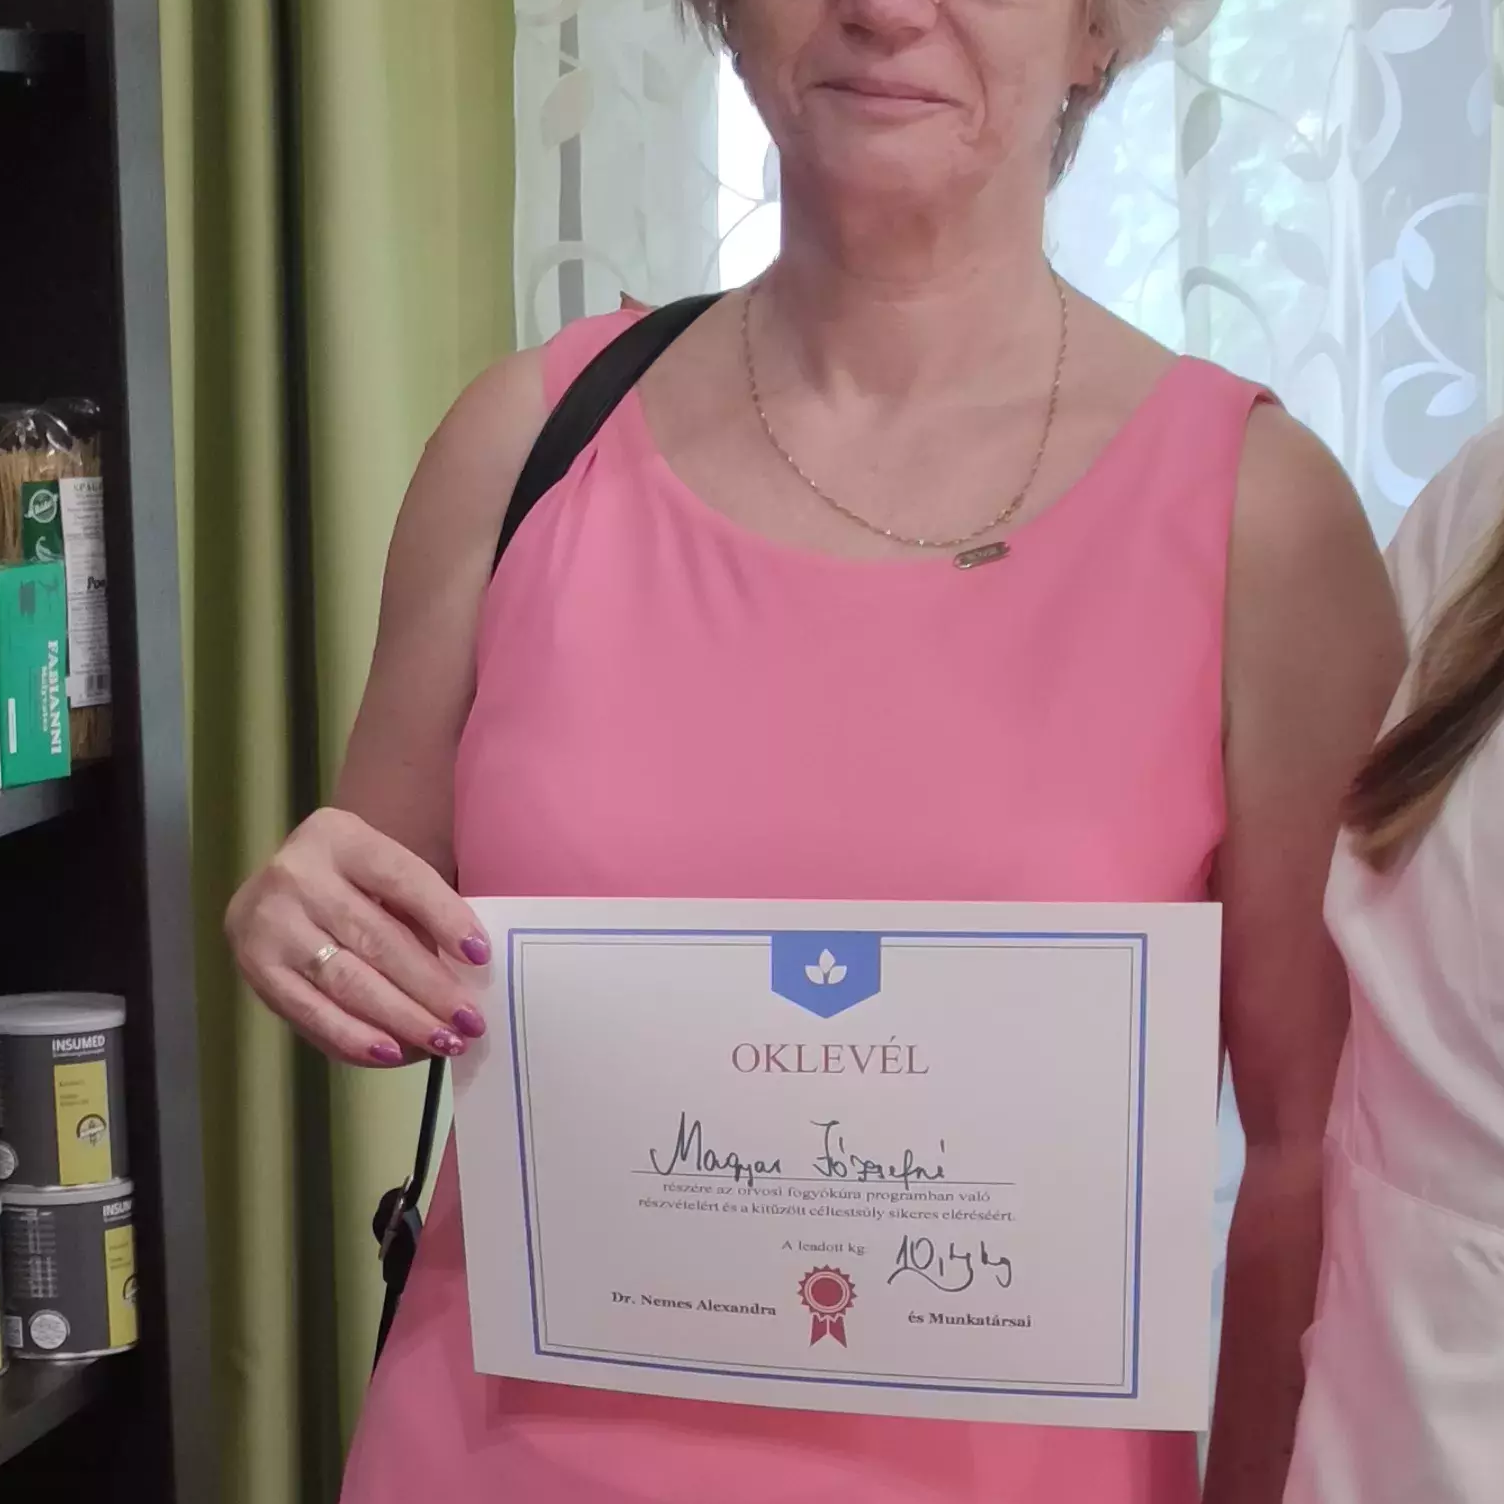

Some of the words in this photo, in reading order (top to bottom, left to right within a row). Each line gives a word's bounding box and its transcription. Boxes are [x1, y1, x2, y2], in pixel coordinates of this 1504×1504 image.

[52, 1034, 106, 1052] INSUMED
[732, 1036, 930, 1076] OKLEVÉL
[649, 1111, 782, 1187] Magyar
[663, 1182, 712, 1194] részére
[717, 1186, 733, 1195] az
[737, 1185, 783, 1196] orvosi
[788, 1187, 861, 1200] fogyókúra
[866, 1189, 955, 1205] programban
[959, 1189, 991, 1202] való
[638, 1197, 719, 1212] részvételért
[722, 1201, 737, 1213] és
[740, 1205, 748, 1214] a
[752, 1202, 807, 1216] kitűzött
[809, 1204, 885, 1221] céltestsúly
[888, 1207, 939, 1220] sikeres
[942, 1209, 1017, 1222] eléréséért.
[782, 1240, 794, 1252] A
[798, 1240, 845, 1254] leadott
[611, 1291, 636, 1306] Dr.
[640, 1294, 693, 1311] Nemes
[696, 1298, 777, 1317] Alexandra
[907, 1310, 925, 1325] és
[929, 1311, 1033, 1329] Munkatársai
